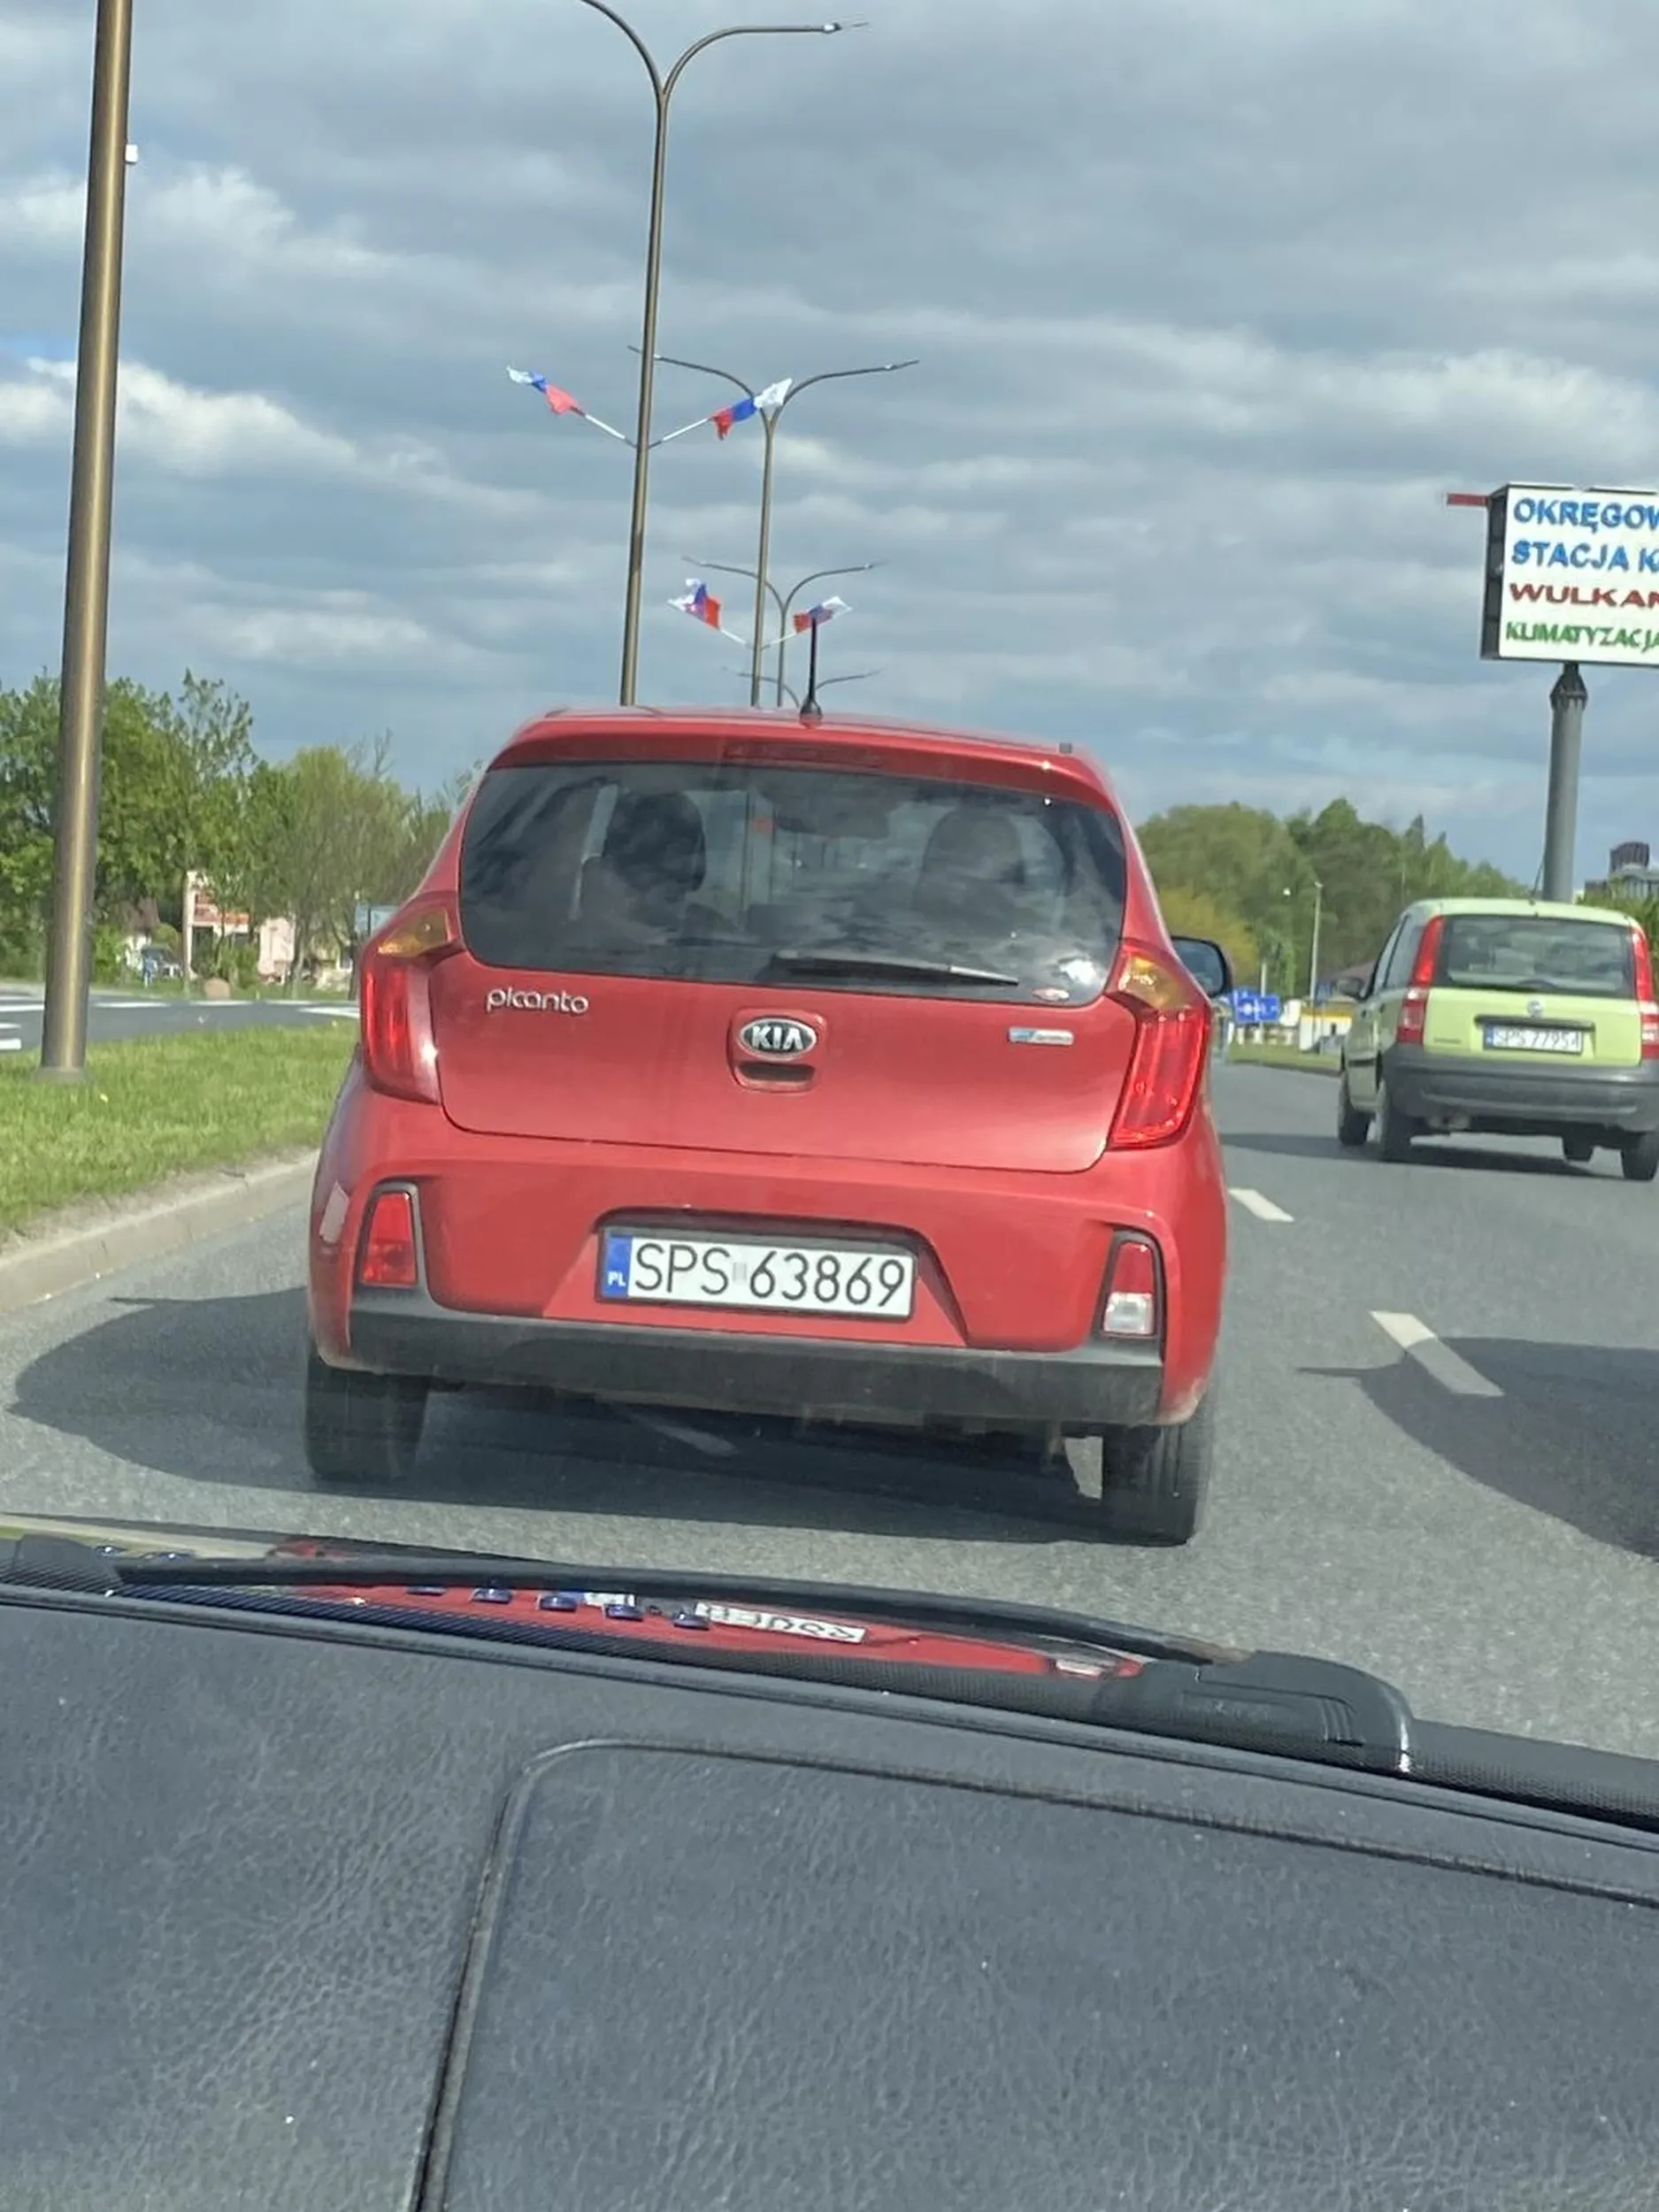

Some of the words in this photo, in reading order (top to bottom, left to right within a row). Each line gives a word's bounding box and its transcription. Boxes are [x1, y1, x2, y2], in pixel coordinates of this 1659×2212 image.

[1511, 539, 1630, 572] STACJA
[751, 1025, 803, 1050] KIA
[607, 1271, 626, 1286] PL
[634, 1242, 731, 1295] SPS
[749, 1250, 905, 1307] 63869
